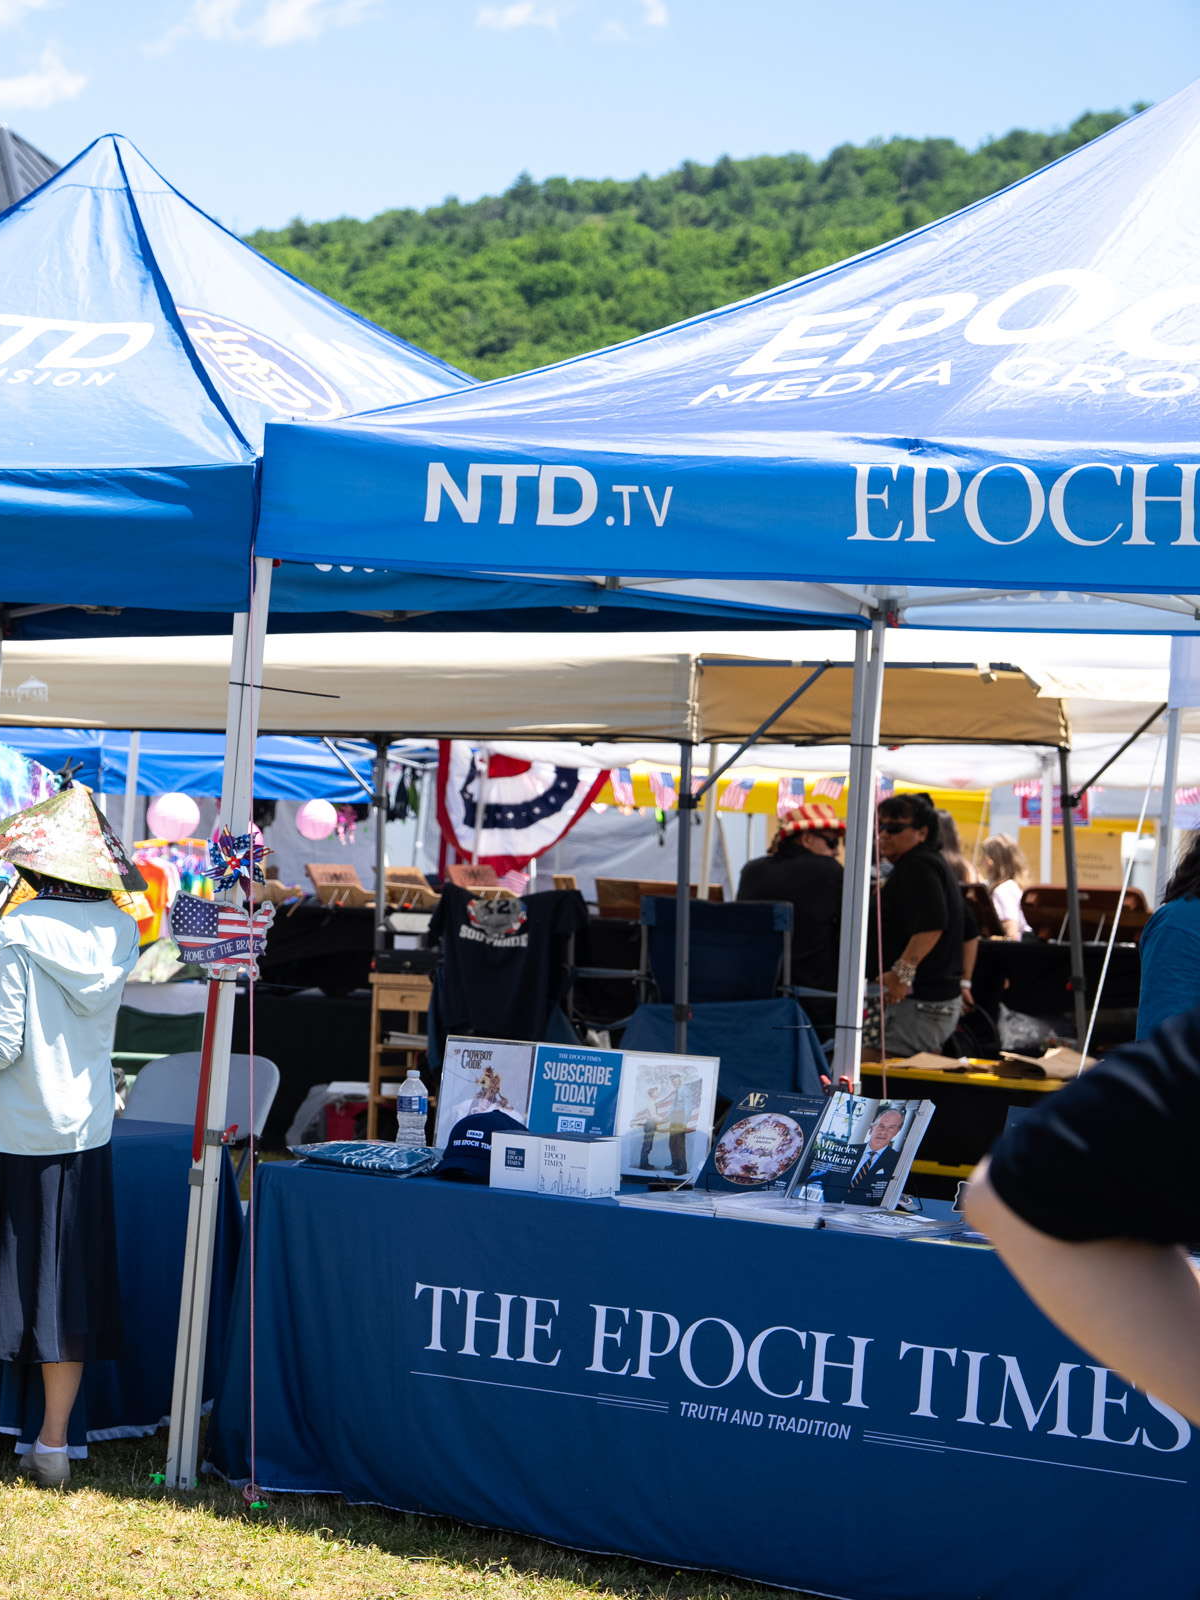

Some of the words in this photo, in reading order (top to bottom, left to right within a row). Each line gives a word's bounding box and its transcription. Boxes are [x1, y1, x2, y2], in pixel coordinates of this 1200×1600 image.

[688, 360, 952, 405] MEDIA
[847, 462, 1200, 546] EPOCH
[184, 950, 205, 961] HOME
[206, 948, 216, 959] OF
[218, 942, 234, 955] THE
[542, 1061, 613, 1086] SUBSCRIBE
[554, 1082, 598, 1105] TODAY!
[462, 1140, 480, 1148] EPOCH
[481, 1143, 492, 1151] TIM
[544, 1144, 557, 1152] THE
[820, 1139, 858, 1154] Miracles
[544, 1152, 566, 1160] EPOCH
[544, 1159, 563, 1167] TIMES
[815, 1150, 856, 1166] Medicine
[414, 1282, 562, 1367] THE
[585, 1303, 875, 1409] EPOCH
[899, 1339, 1192, 1453] TIMES
[679, 1401, 729, 1426] TRUTH
[731, 1408, 763, 1429] AND
[766, 1411, 852, 1441] TRADITION
